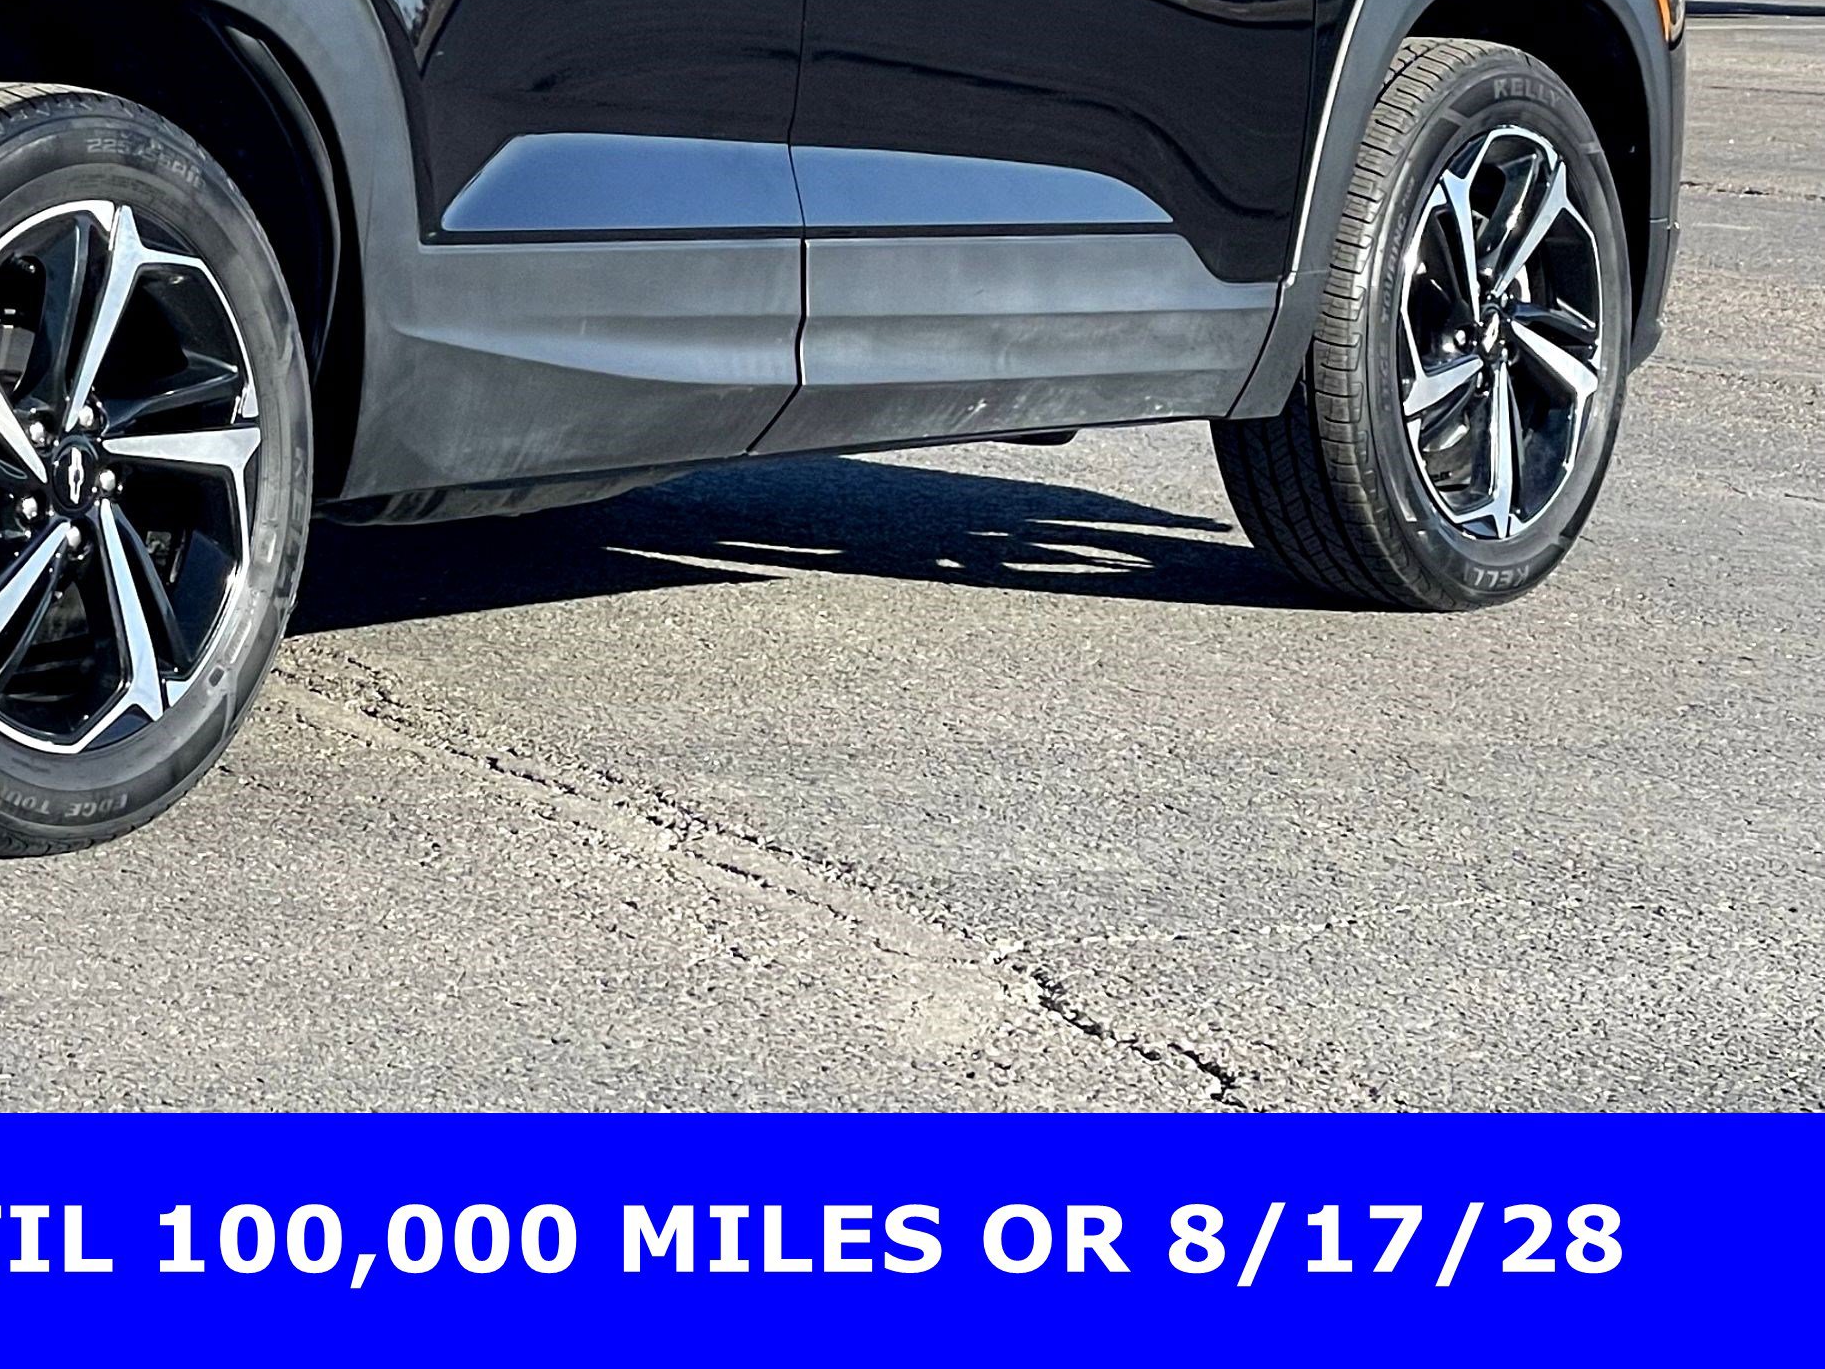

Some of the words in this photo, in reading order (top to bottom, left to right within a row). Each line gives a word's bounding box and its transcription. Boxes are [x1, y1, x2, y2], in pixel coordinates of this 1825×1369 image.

[1493, 77, 1562, 107] KELLY
[1380, 212, 1408, 324] TOURING
[63, 792, 129, 819] EDGE
